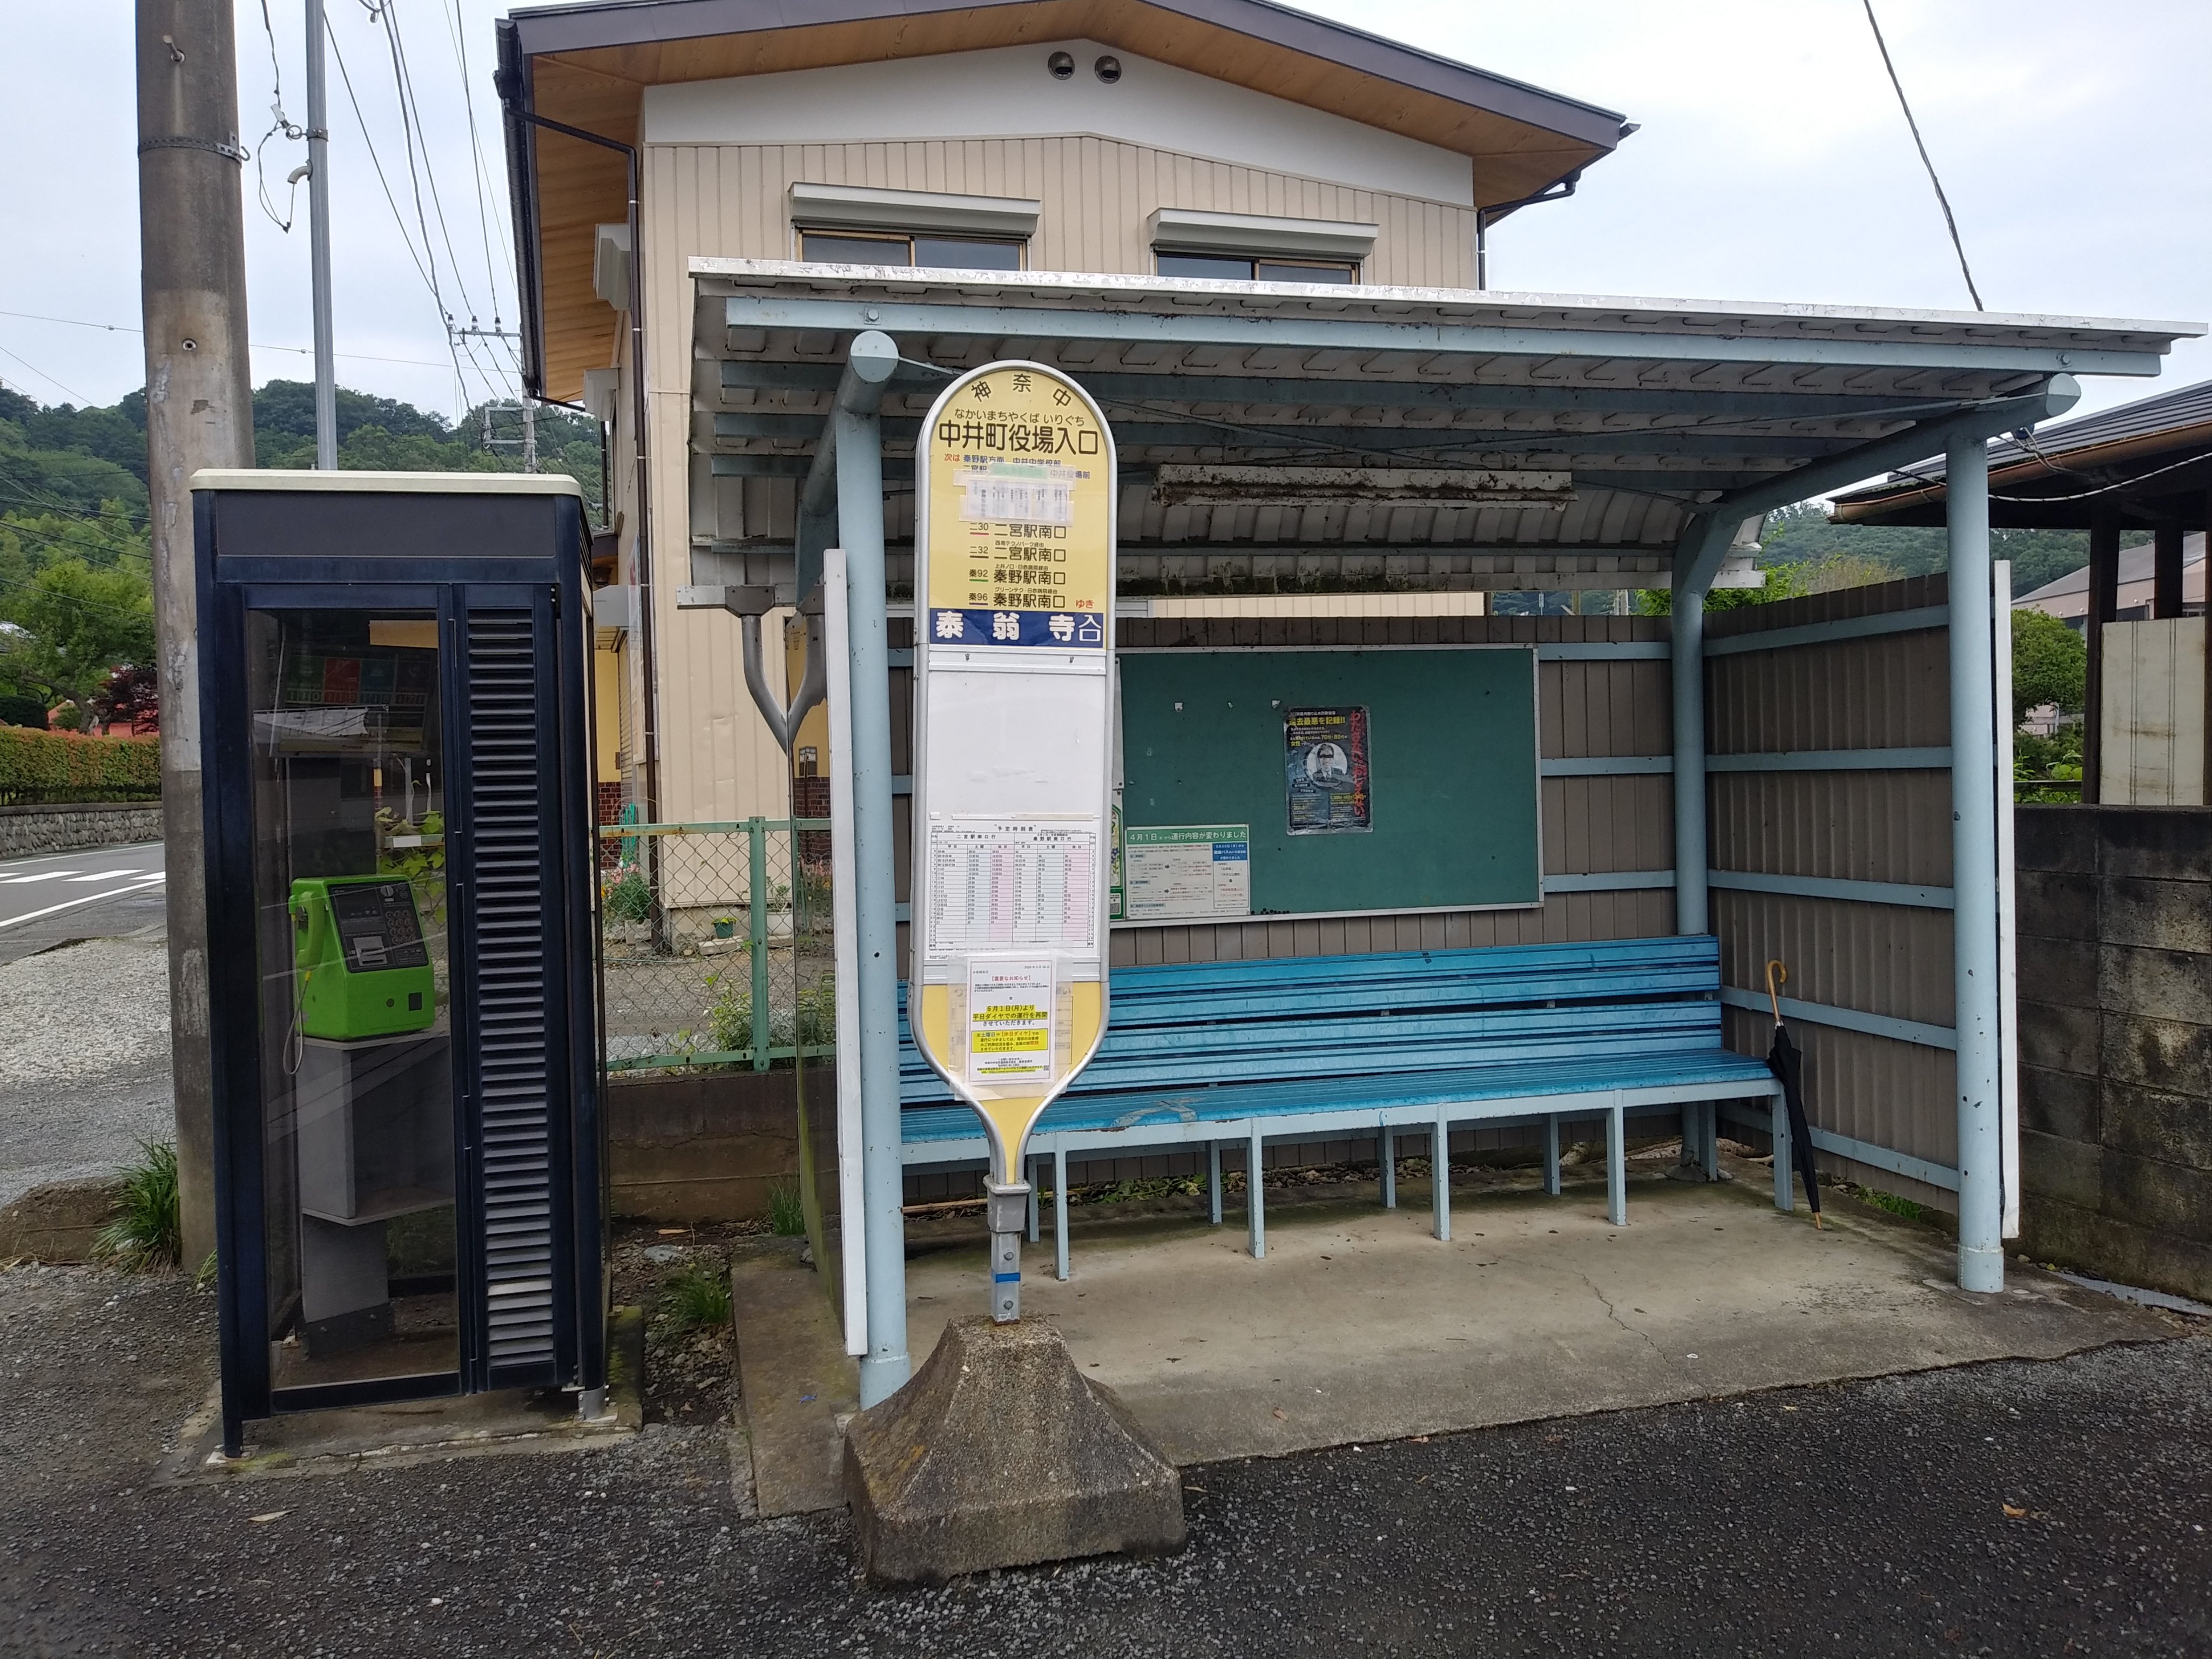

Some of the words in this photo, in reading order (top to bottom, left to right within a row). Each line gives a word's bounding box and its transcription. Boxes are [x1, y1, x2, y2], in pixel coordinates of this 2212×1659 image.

[939, 419, 1098, 455] 中井町役場入口
[945, 454, 960, 462] 次は
[963, 455, 1004, 463] 秦野駅方面
[1013, 457, 1061, 467] 中井中学校前
[994, 523, 1066, 539] 二宮駅南口
[994, 547, 1066, 562] 二宮駅南口
[969, 569, 988, 578] 秦92
[994, 569, 1065, 585] 秦野駅南口
[968, 592, 988, 601] 秦96
[993, 593, 1065, 608] 秦野駅南口
[1076, 599, 1094, 609] ゆき
